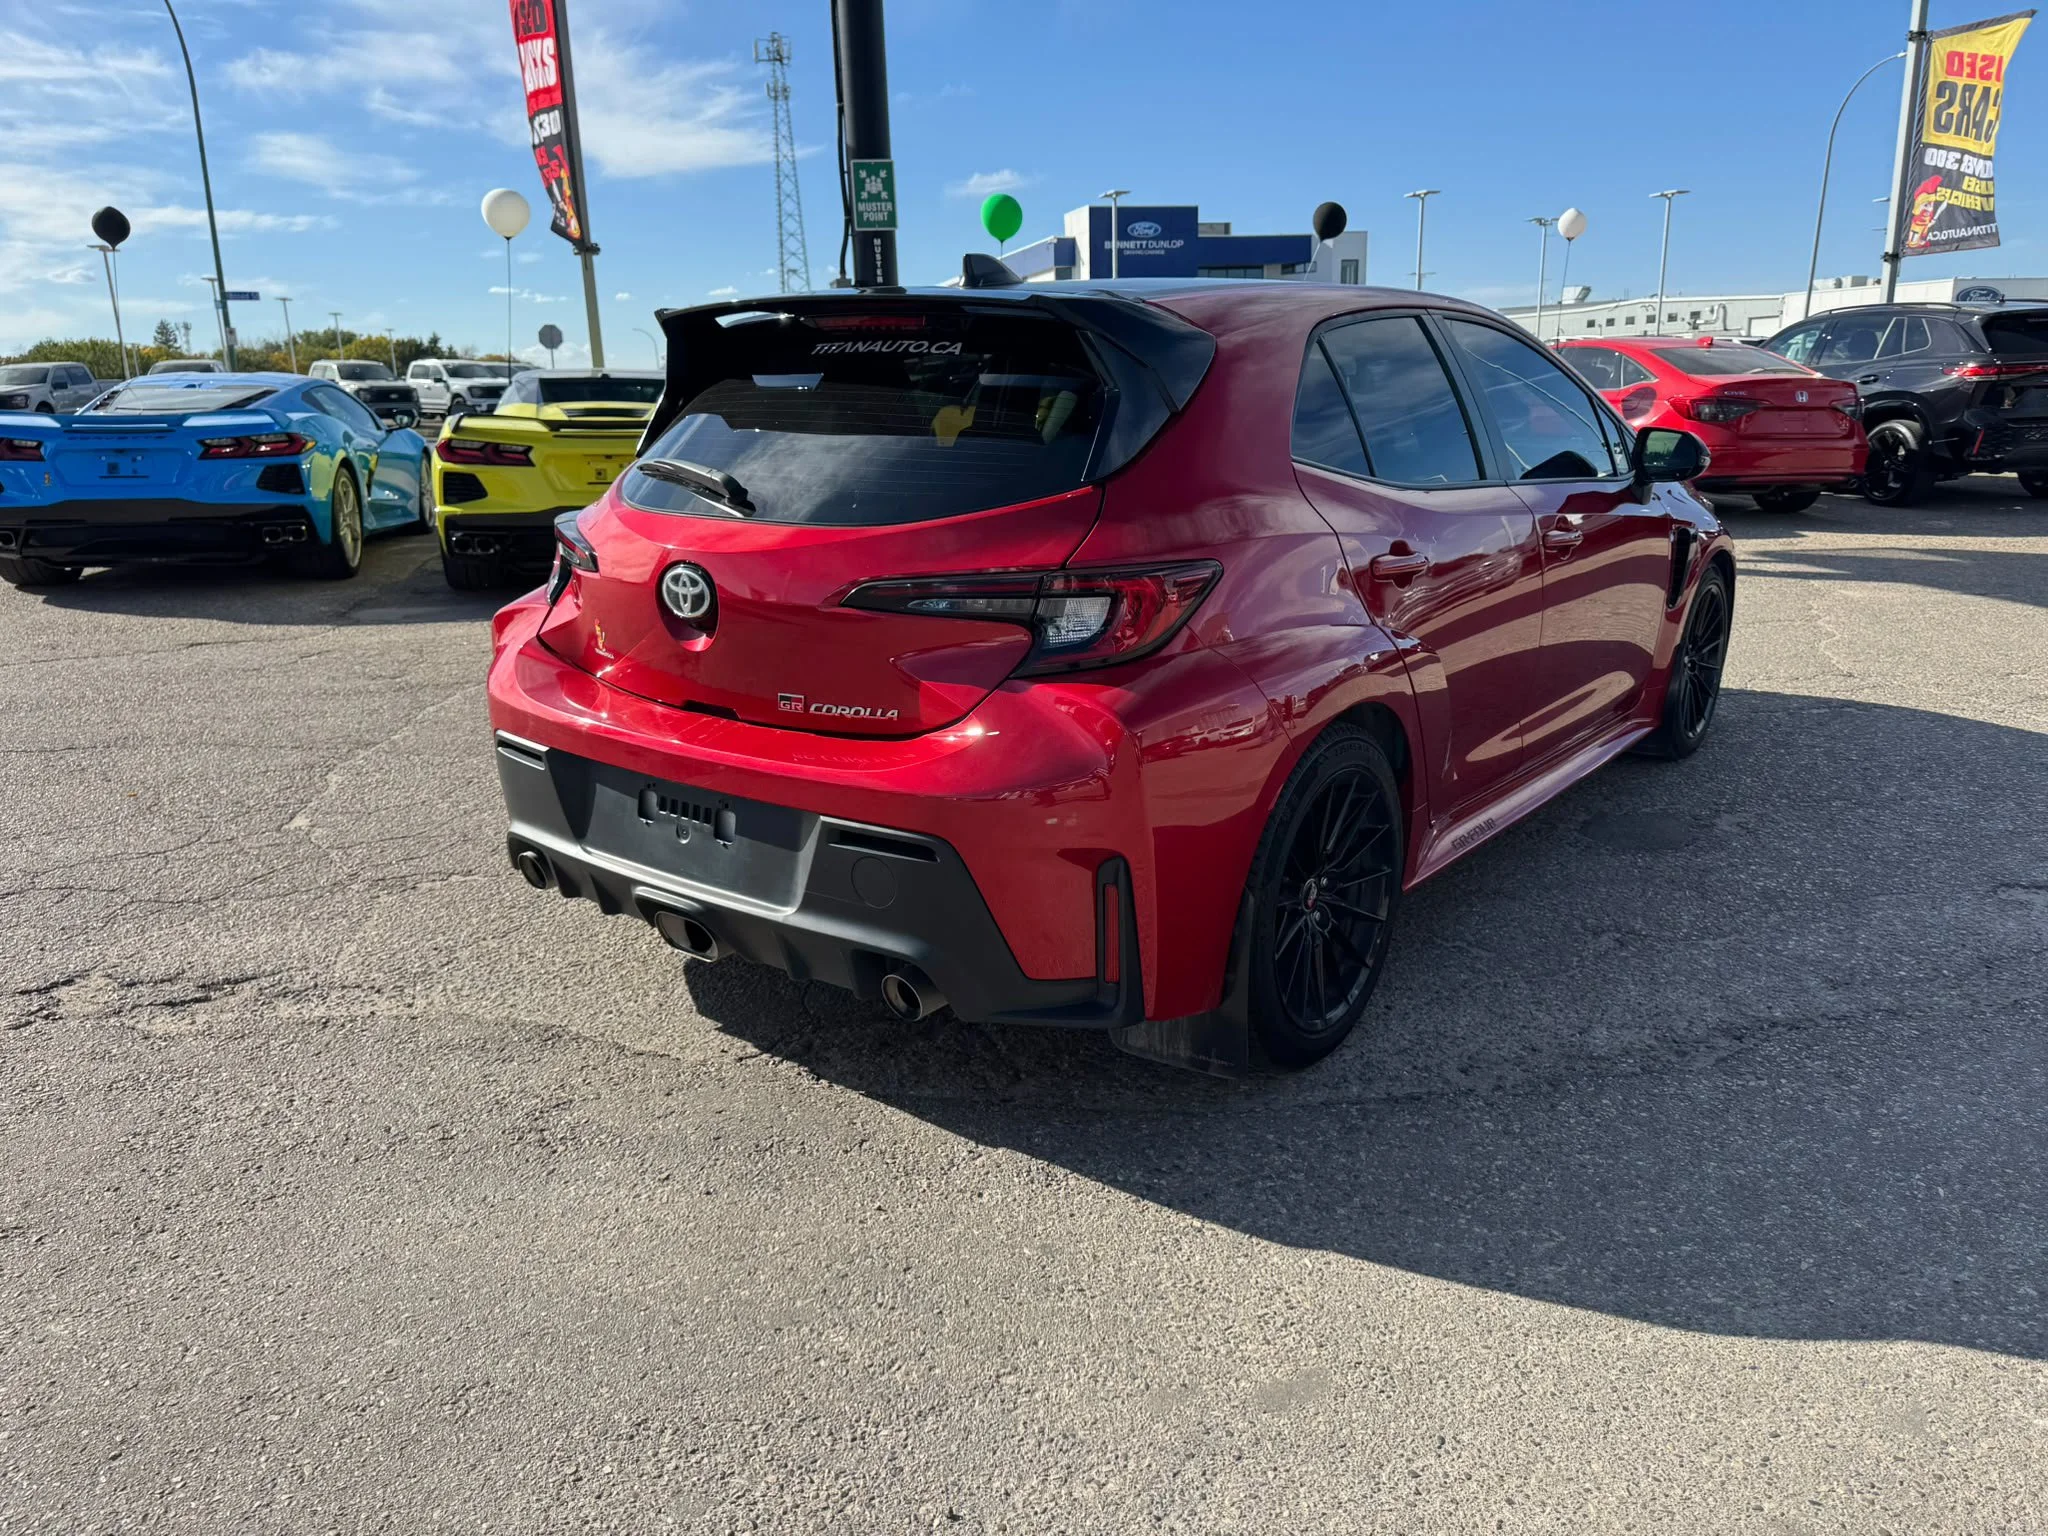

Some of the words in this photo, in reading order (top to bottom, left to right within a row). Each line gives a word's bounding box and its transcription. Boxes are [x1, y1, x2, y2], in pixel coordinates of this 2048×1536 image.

[858, 202, 893, 212] MUSTER
[863, 212, 889, 221] POINT
[1104, 240, 1147, 249] BNNETT
[1148, 240, 1185, 248] DUNLOP
[873, 238, 884, 283] MUSTER
[811, 340, 963, 355] TITANAUTO.CA
[809, 703, 899, 721] COROLLA
